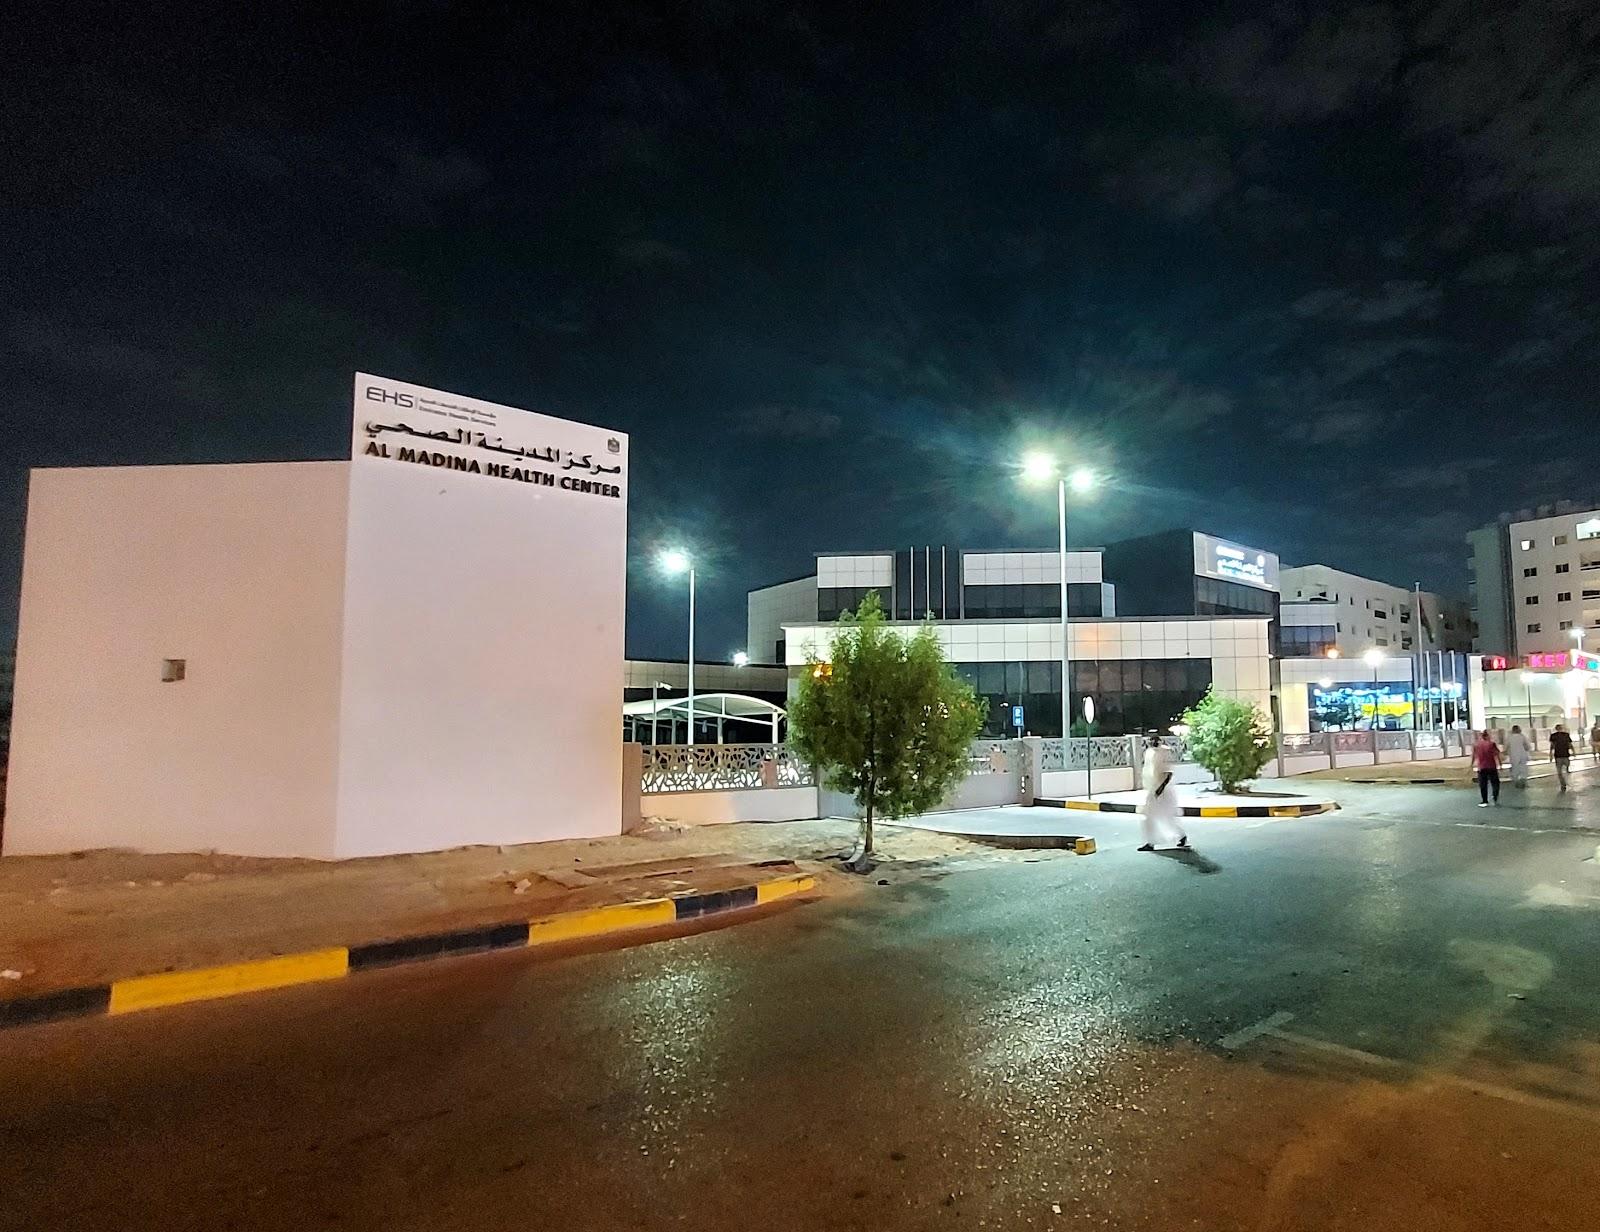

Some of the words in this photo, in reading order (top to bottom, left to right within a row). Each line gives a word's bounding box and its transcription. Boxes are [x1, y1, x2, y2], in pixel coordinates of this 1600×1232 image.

[366, 386, 414, 408] EHS
[364, 421, 472, 446] الصحي
[476, 432, 560, 463] المدينة
[364, 441, 391, 458] AL
[398, 446, 481, 474] MADINA
[487, 462, 555, 487] HEALTH
[560, 476, 620, 498] CENTER
[562, 451, 621, 476] مركز
